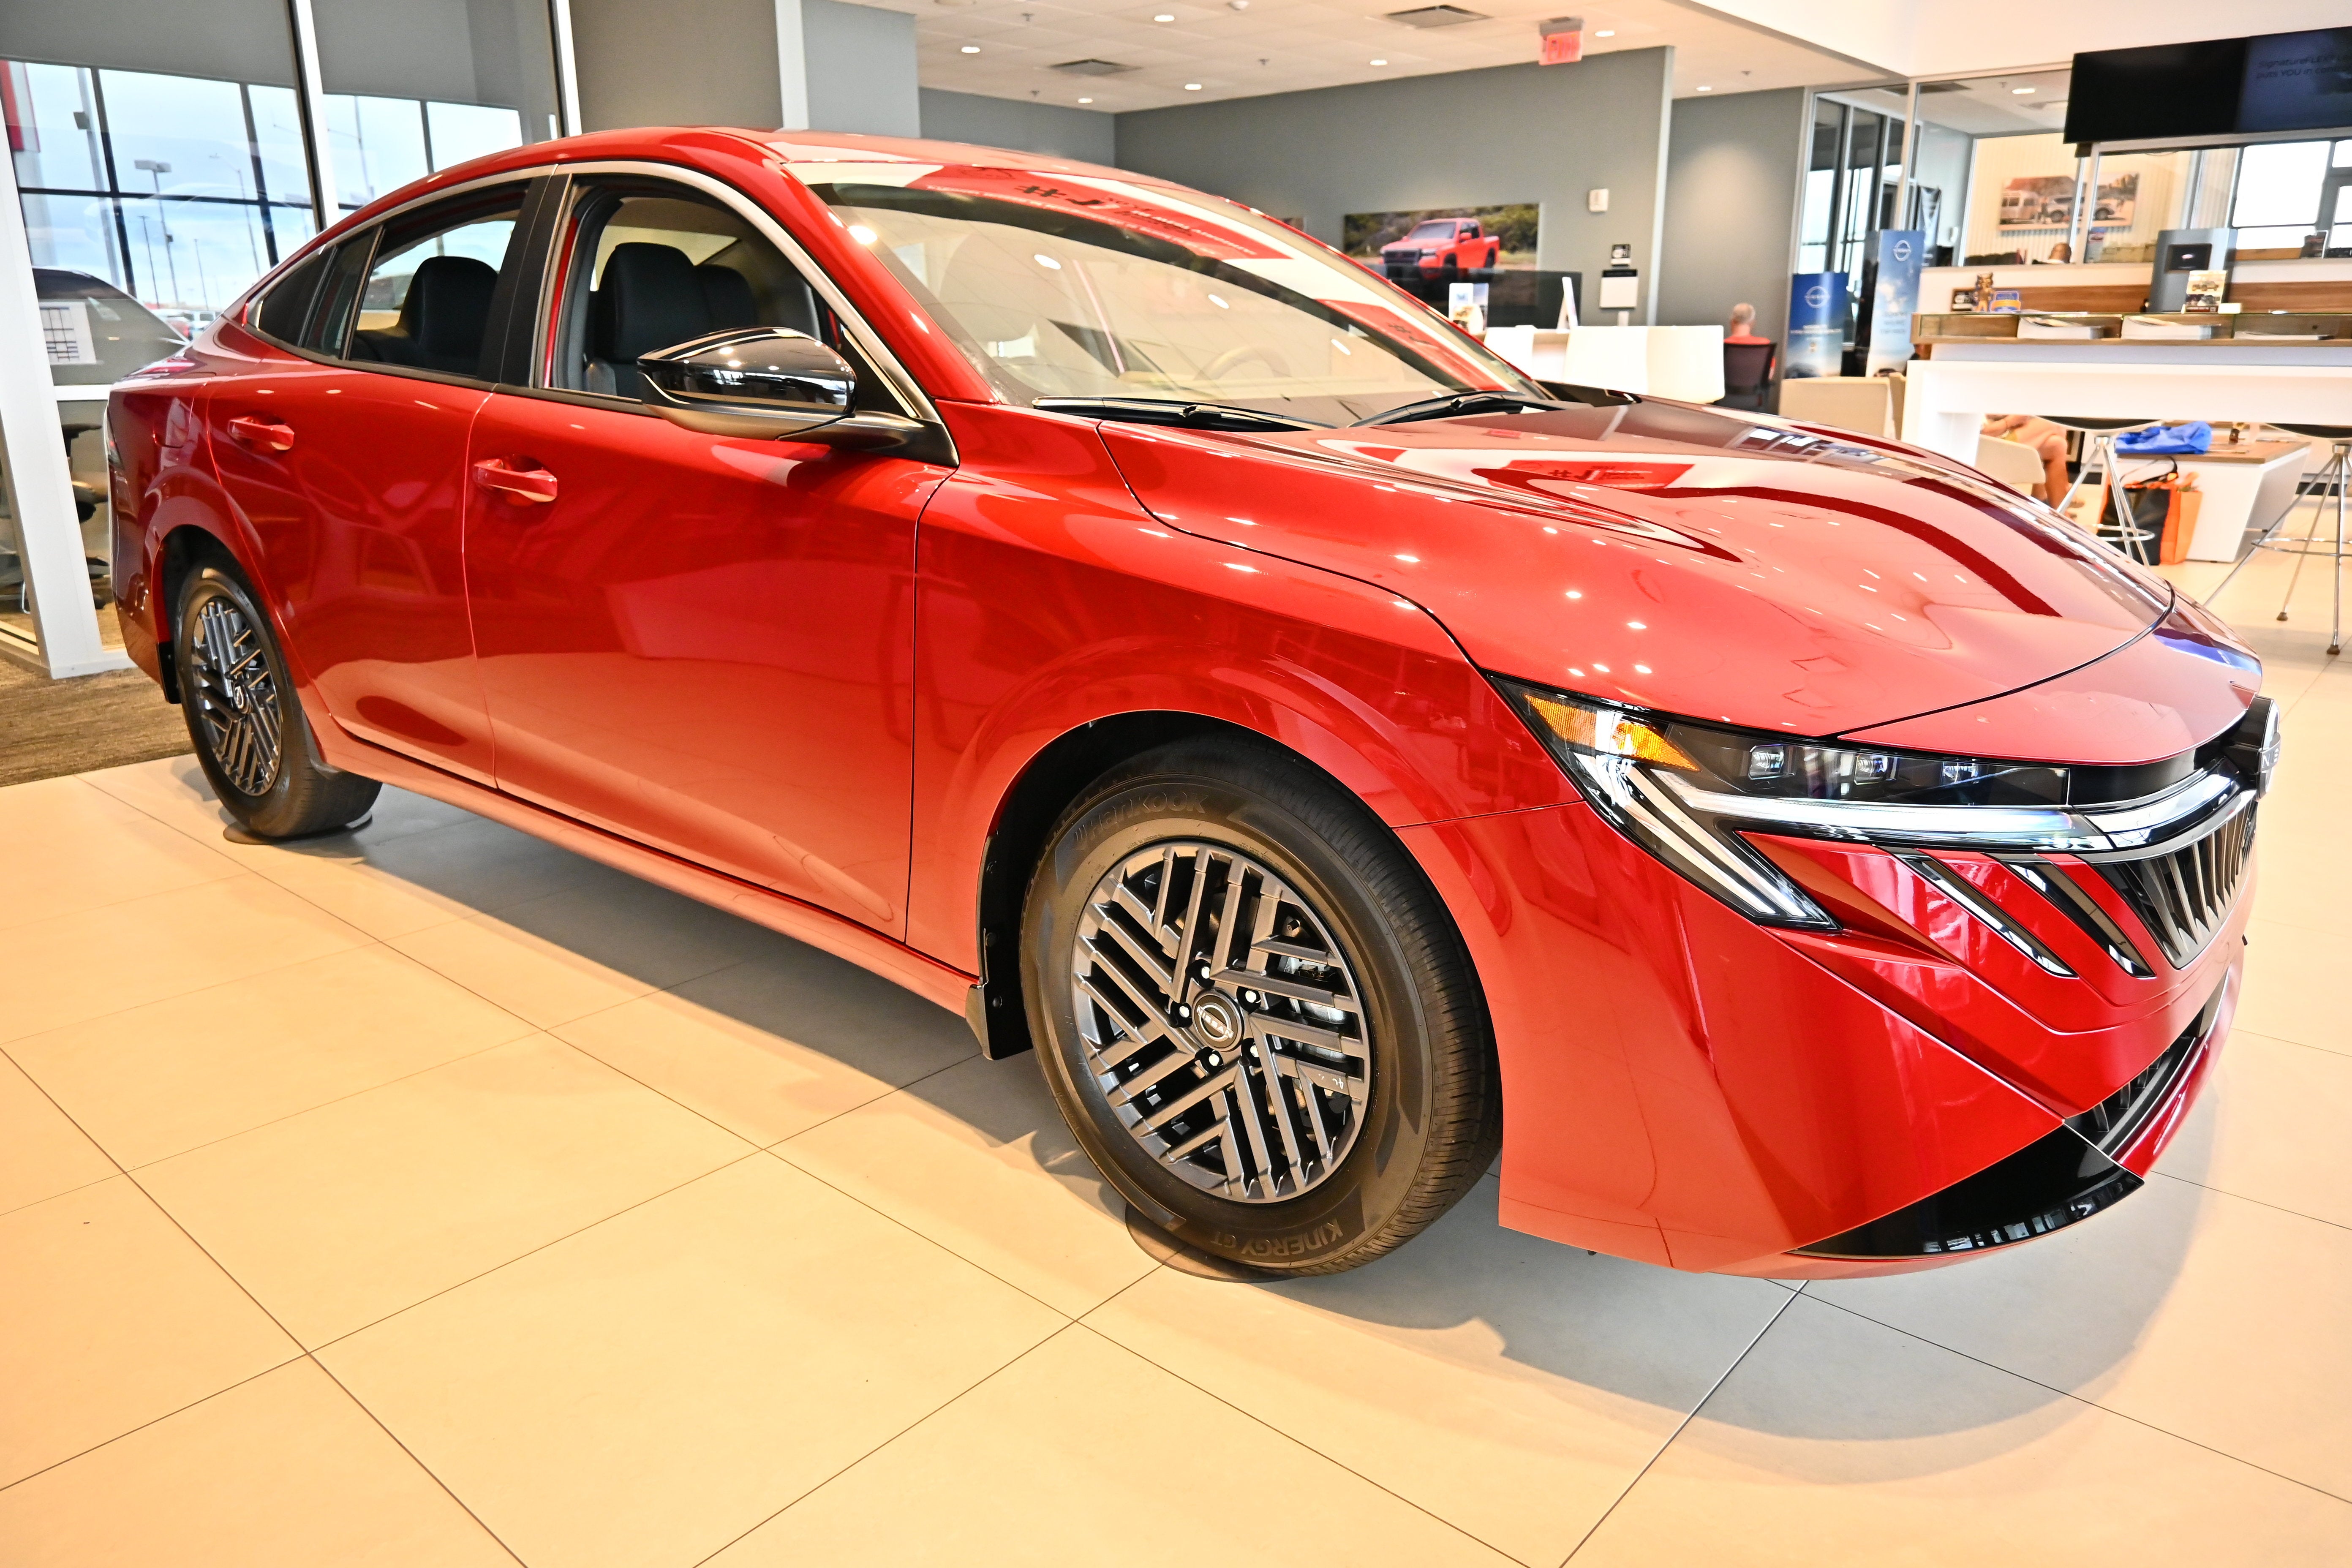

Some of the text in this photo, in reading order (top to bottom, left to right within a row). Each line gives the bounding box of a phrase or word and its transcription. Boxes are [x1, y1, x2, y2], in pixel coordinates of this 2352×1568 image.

[2281, 68, 2302, 76] YOU
[1196, 1005, 1234, 1039] NISSAN
[1210, 1217, 1344, 1257] KINERGY GT
